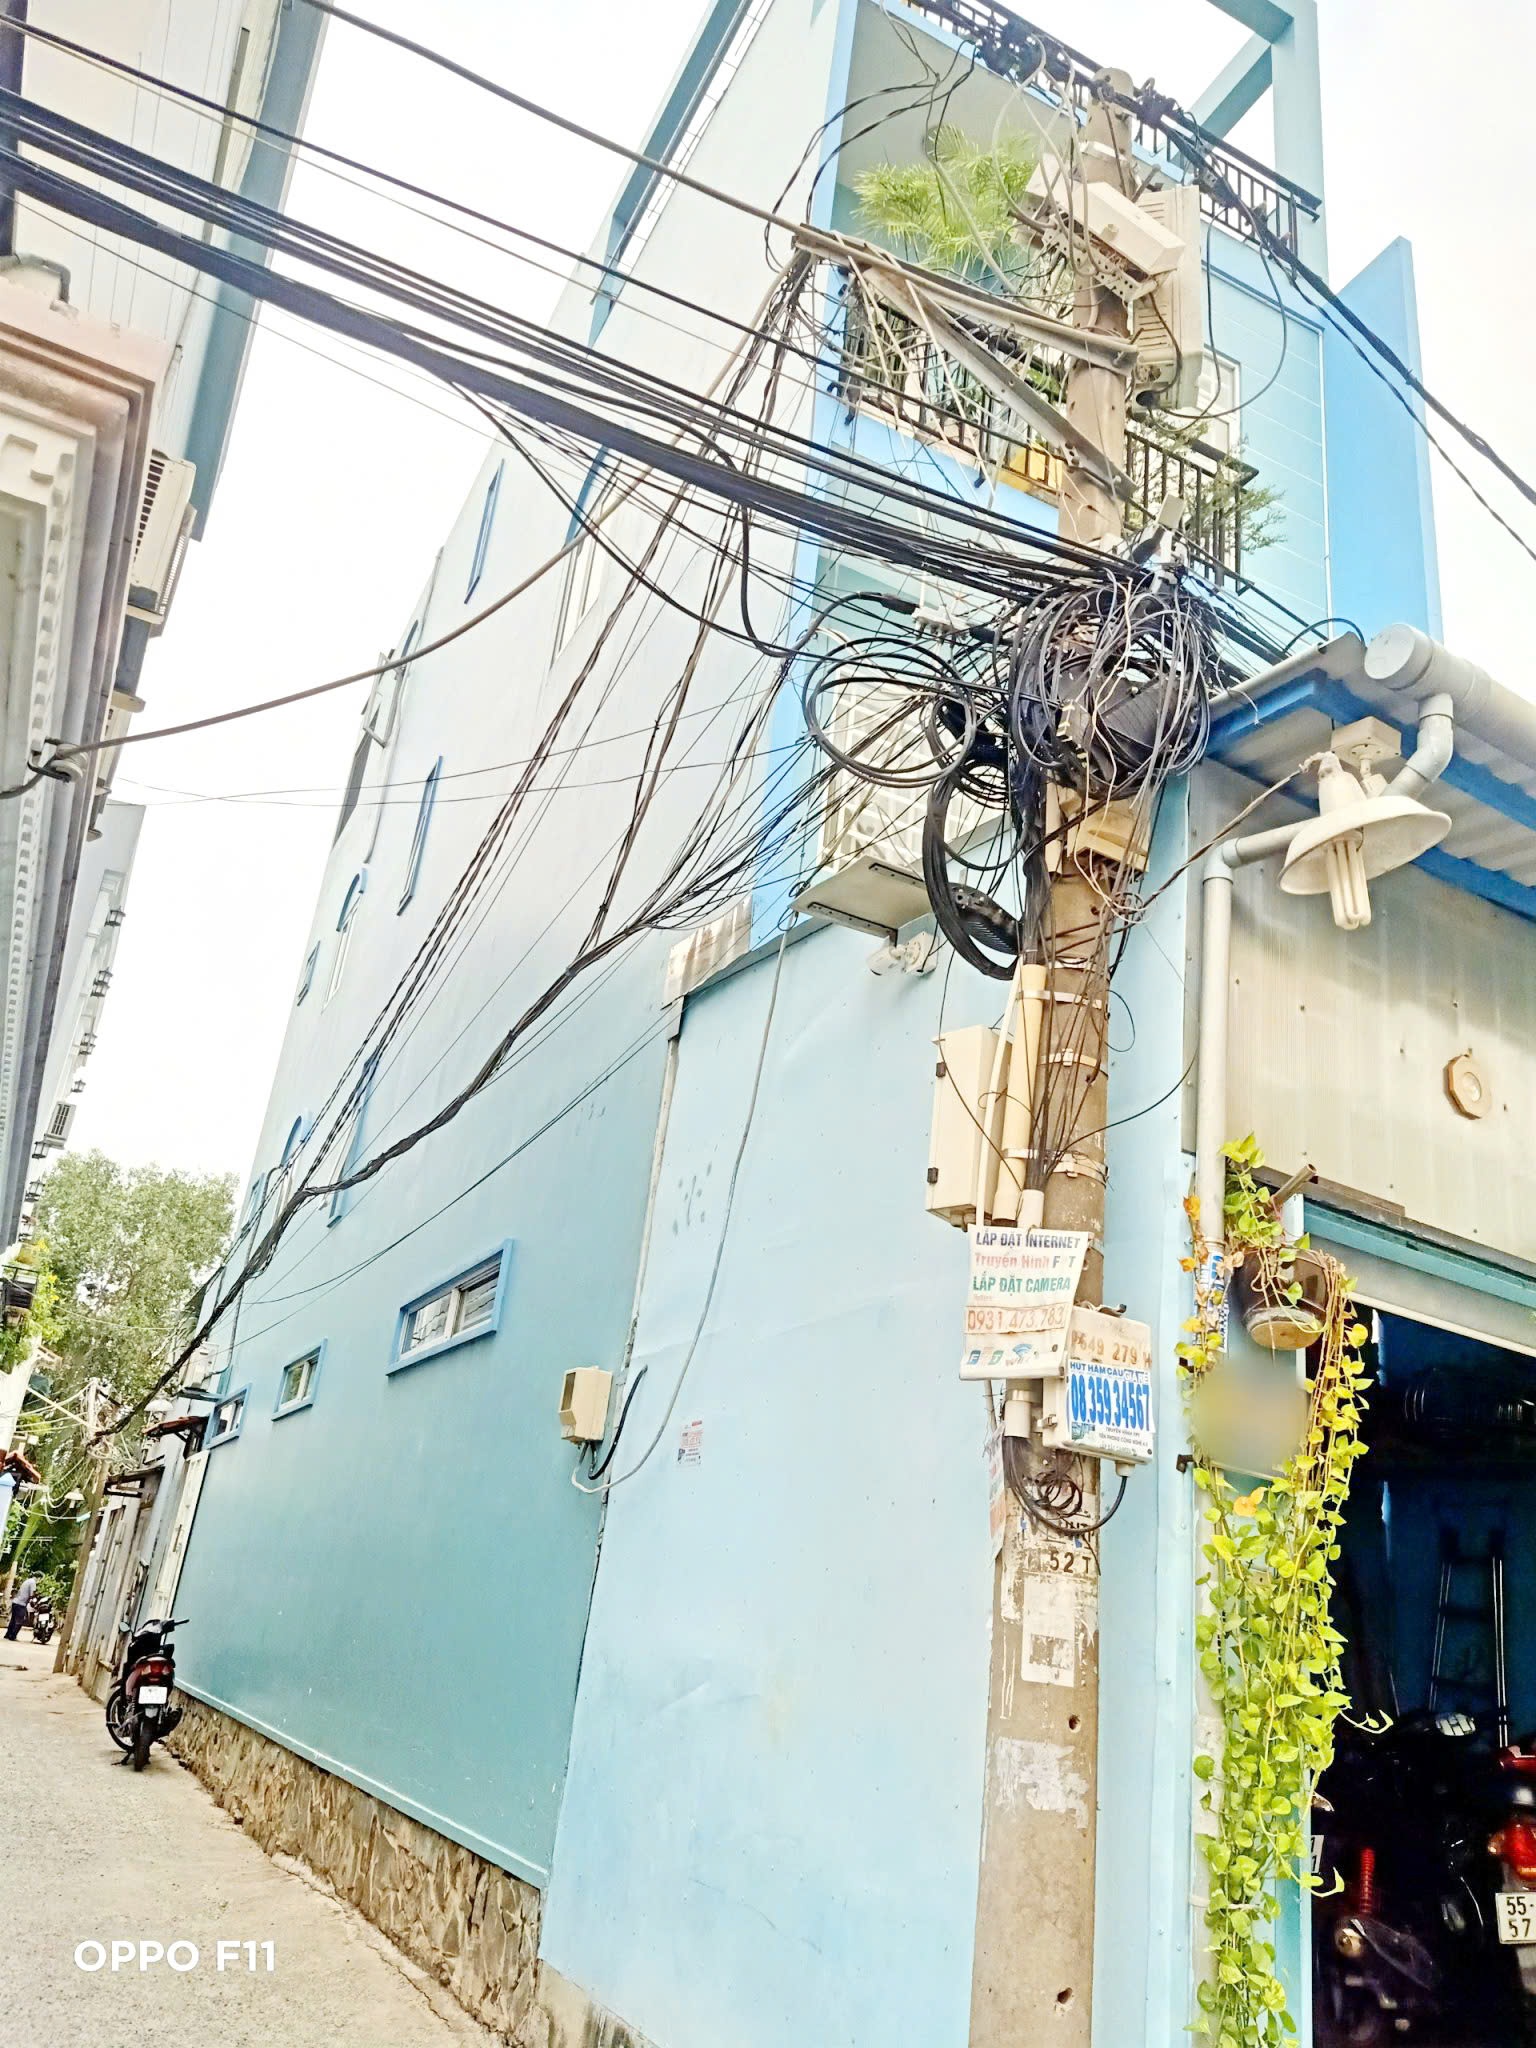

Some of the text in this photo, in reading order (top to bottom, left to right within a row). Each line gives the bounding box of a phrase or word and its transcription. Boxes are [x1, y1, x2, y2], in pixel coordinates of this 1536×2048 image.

[1025, 1233, 1081, 1249] INTERNET
[1025, 1277, 1071, 1293] CAMERA
[1070, 1373, 1150, 1432] 08.359.34567
